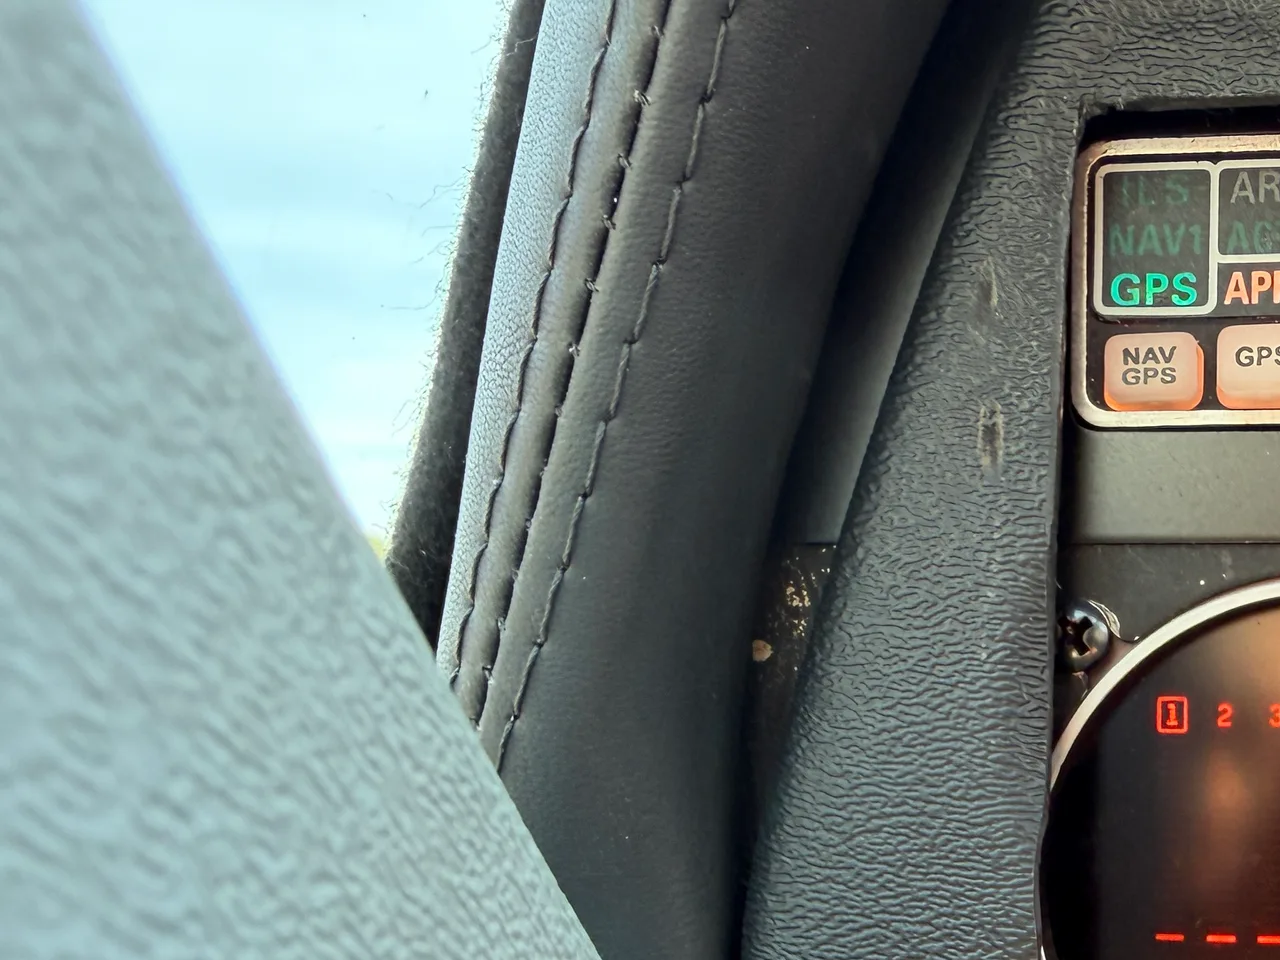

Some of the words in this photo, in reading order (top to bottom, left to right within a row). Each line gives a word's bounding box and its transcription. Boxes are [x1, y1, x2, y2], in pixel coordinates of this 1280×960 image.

[1110, 271, 1198, 307] GPS
[1122, 346, 1177, 366] NAV
[1121, 366, 1178, 386] GPS
[1217, 704, 1233, 727] 2
